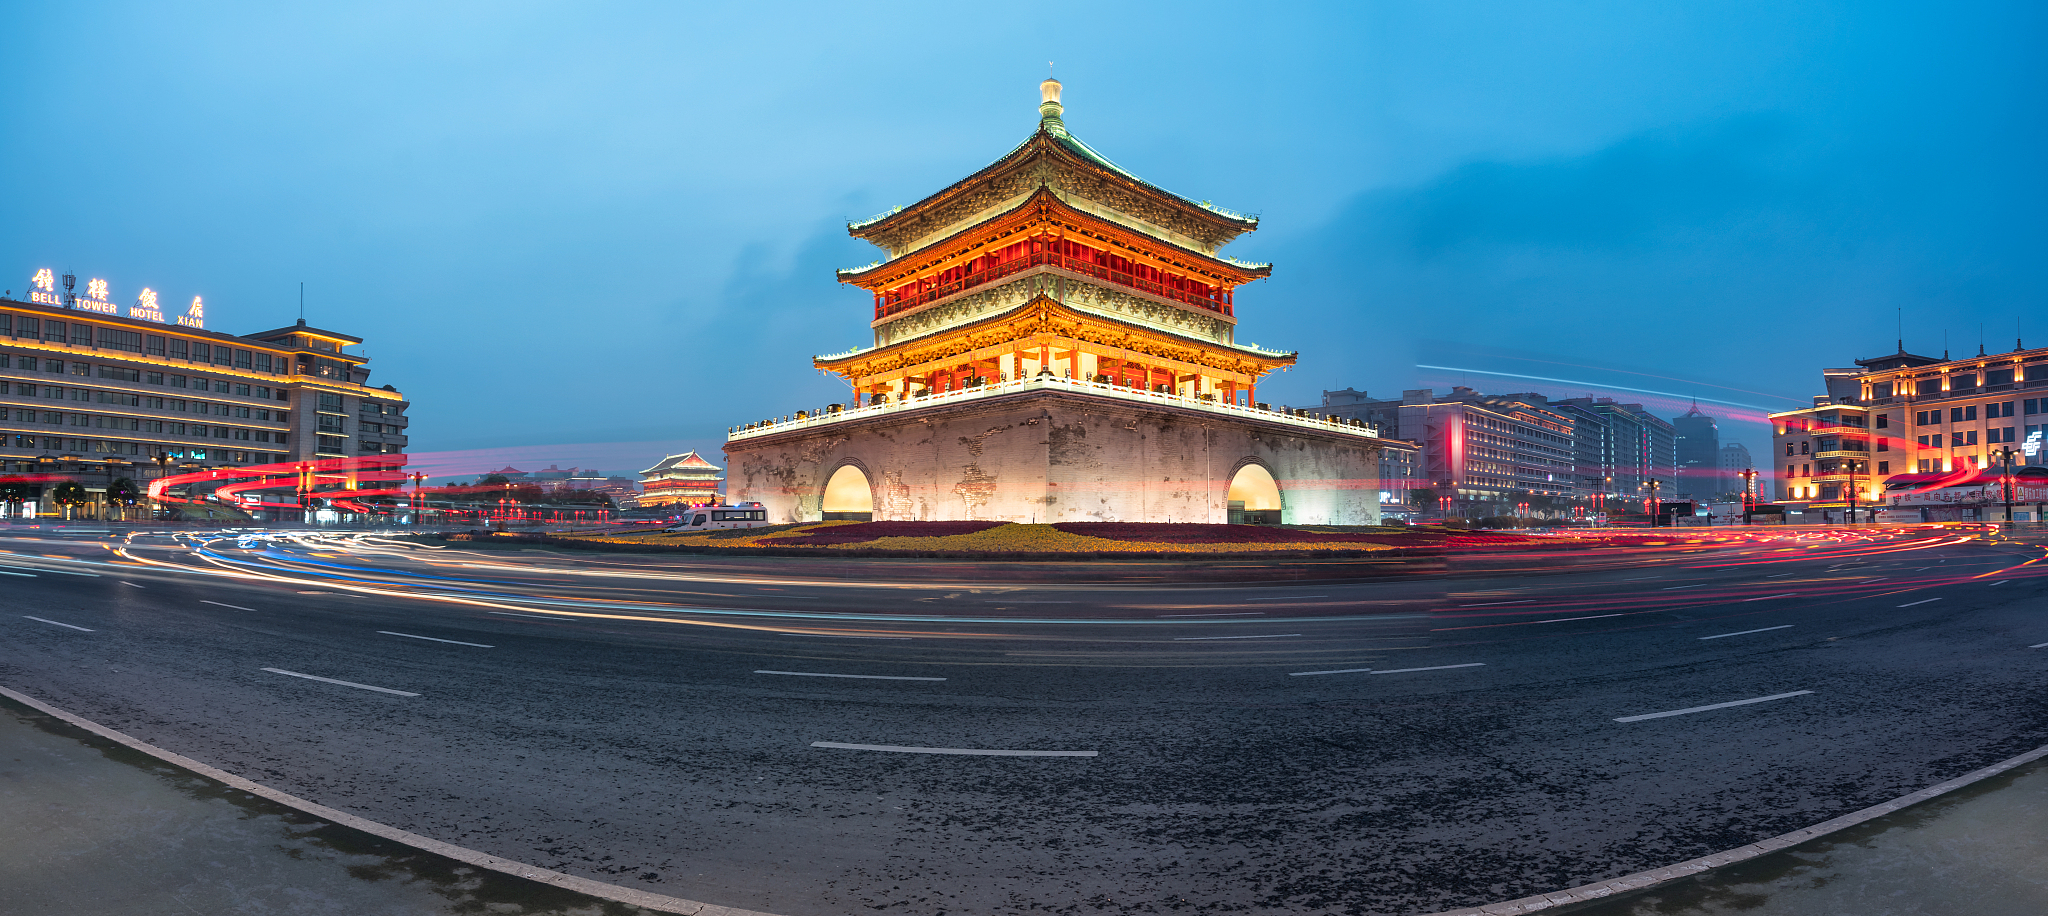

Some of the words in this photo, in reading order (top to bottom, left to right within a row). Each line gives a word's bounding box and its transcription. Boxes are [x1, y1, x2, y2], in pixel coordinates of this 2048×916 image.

[32, 291, 62, 306] BELL
[75, 298, 117, 314] TOWER
[130, 306, 165, 322] HOTEL
[177, 315, 203, 329] XIAN
